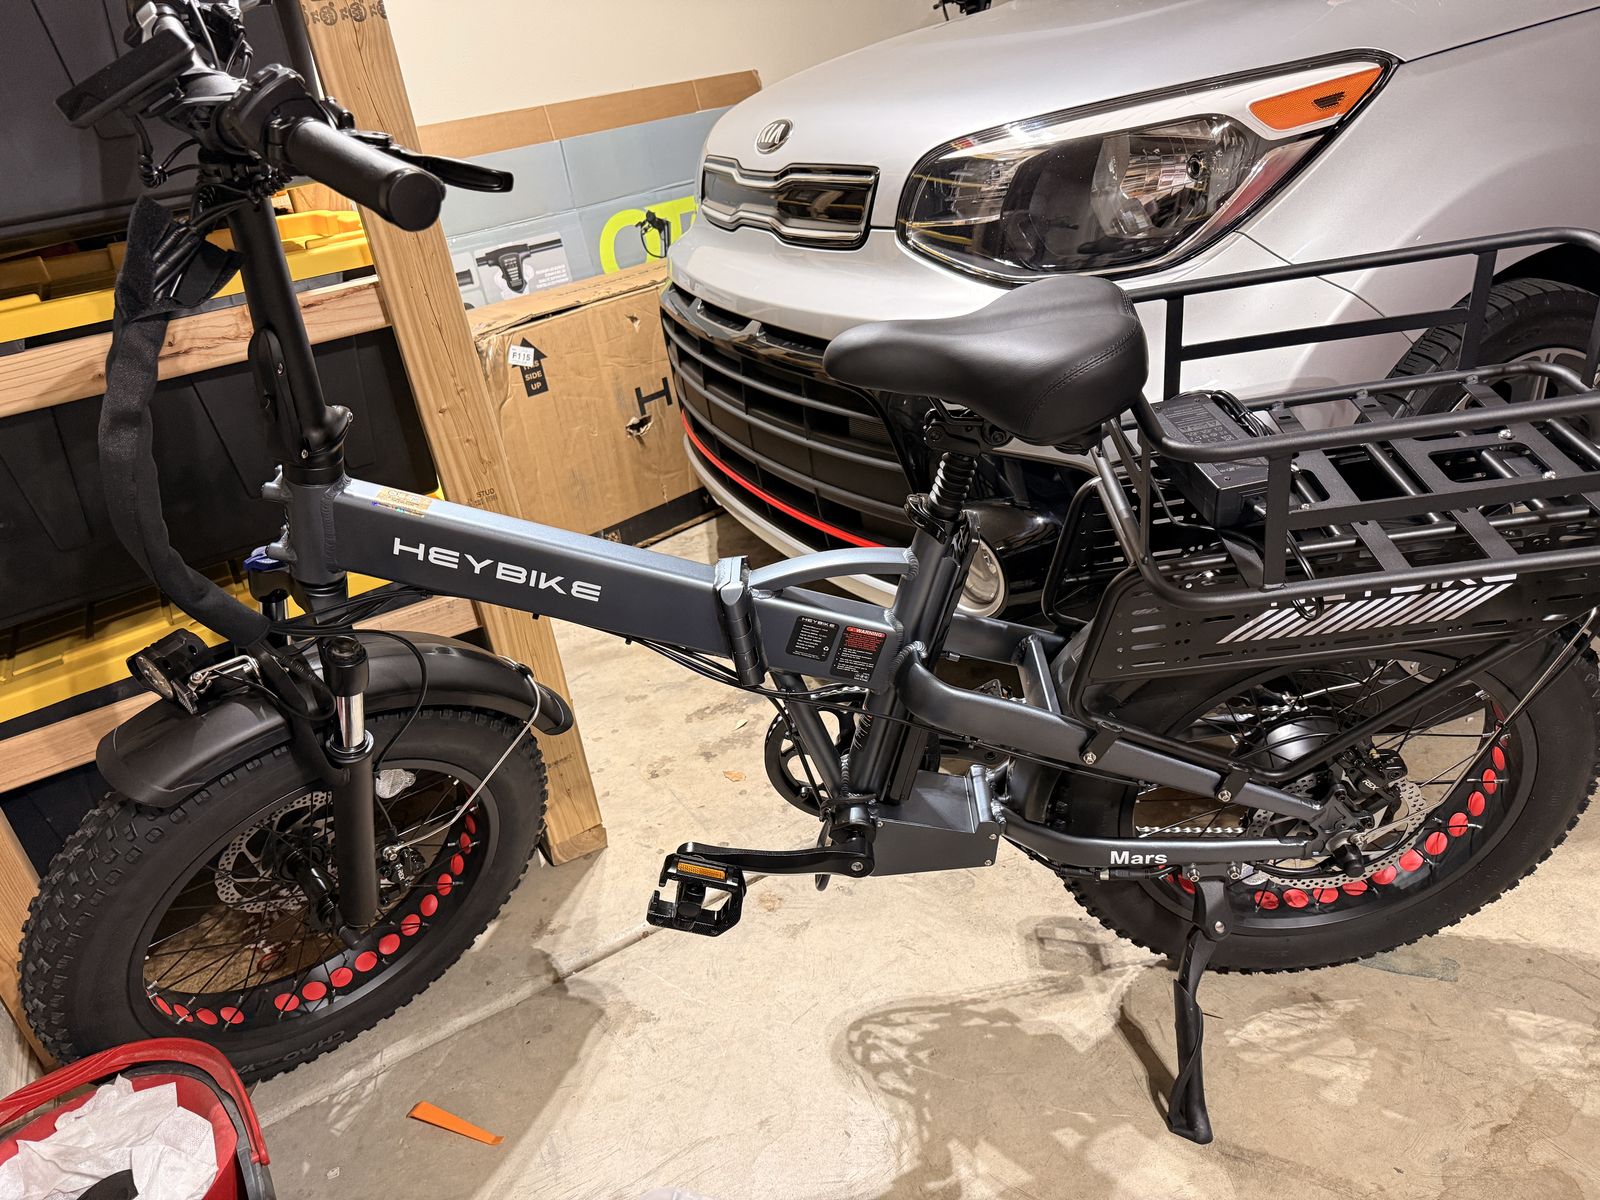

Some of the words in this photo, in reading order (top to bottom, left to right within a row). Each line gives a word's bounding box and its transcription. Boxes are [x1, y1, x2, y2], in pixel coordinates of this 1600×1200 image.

[758, 123, 786, 144] KIA
[512, 352, 531, 361] F115
[525, 371, 542, 381] SIDE
[531, 382, 542, 390] UP
[476, 488, 495, 497] STUD
[393, 537, 602, 602] HEYBIKE
[802, 617, 835, 628] HEYBIKE
[856, 628, 884, 638] WARNING
[1110, 851, 1168, 865] Mars
